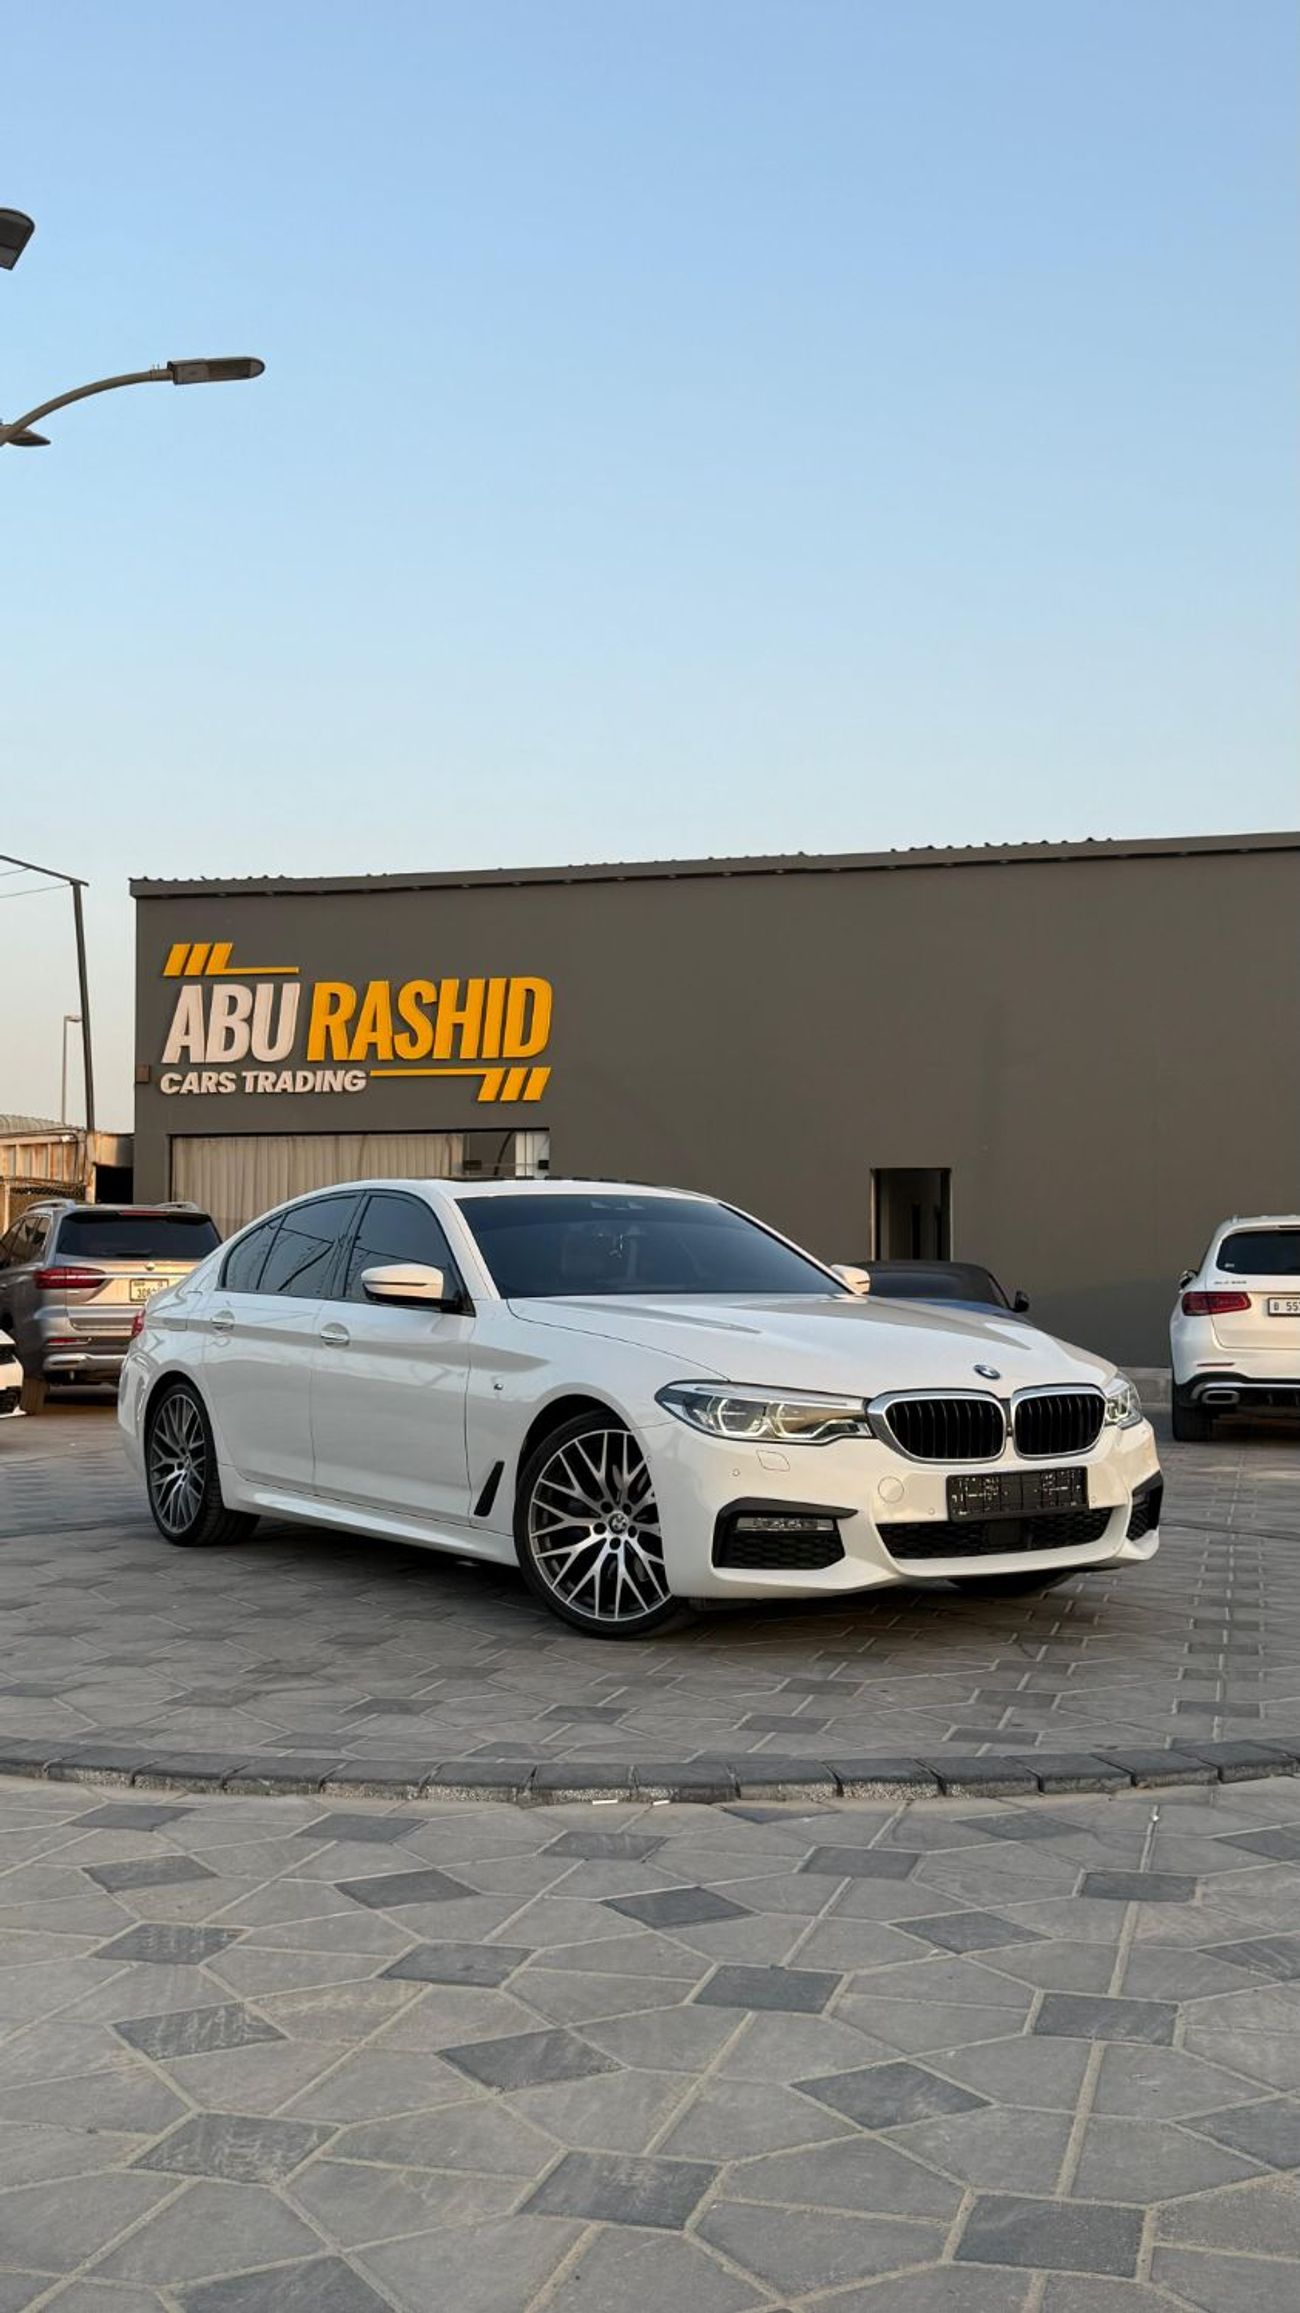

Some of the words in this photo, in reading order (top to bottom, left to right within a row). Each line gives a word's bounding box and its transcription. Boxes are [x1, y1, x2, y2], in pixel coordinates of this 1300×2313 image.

[161, 983, 301, 1064] ABU
[306, 976, 553, 1062] RASHID
[159, 1071, 237, 1095] CARS
[242, 1069, 368, 1094] TRADING
[1286, 1302, 1300, 1311] 55
